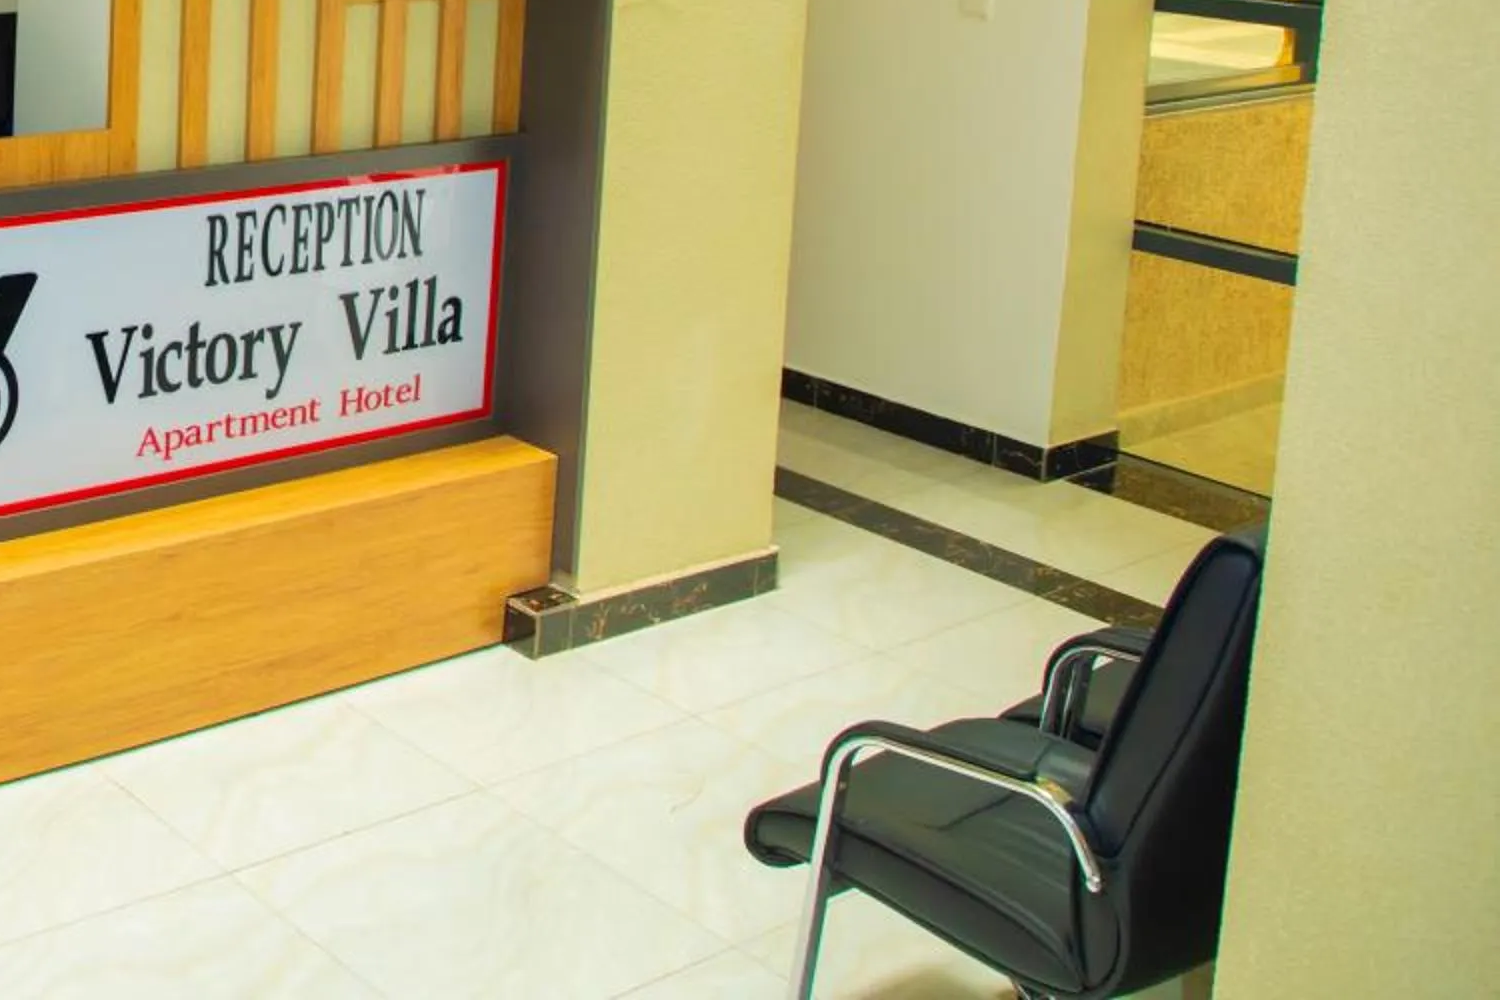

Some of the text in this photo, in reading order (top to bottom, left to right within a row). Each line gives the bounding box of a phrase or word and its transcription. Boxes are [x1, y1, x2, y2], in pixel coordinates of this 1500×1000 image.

[204, 189, 426, 287] RECEPTION
[85, 275, 464, 405] Victory Villa
[135, 375, 422, 460] Apartment Hotel
